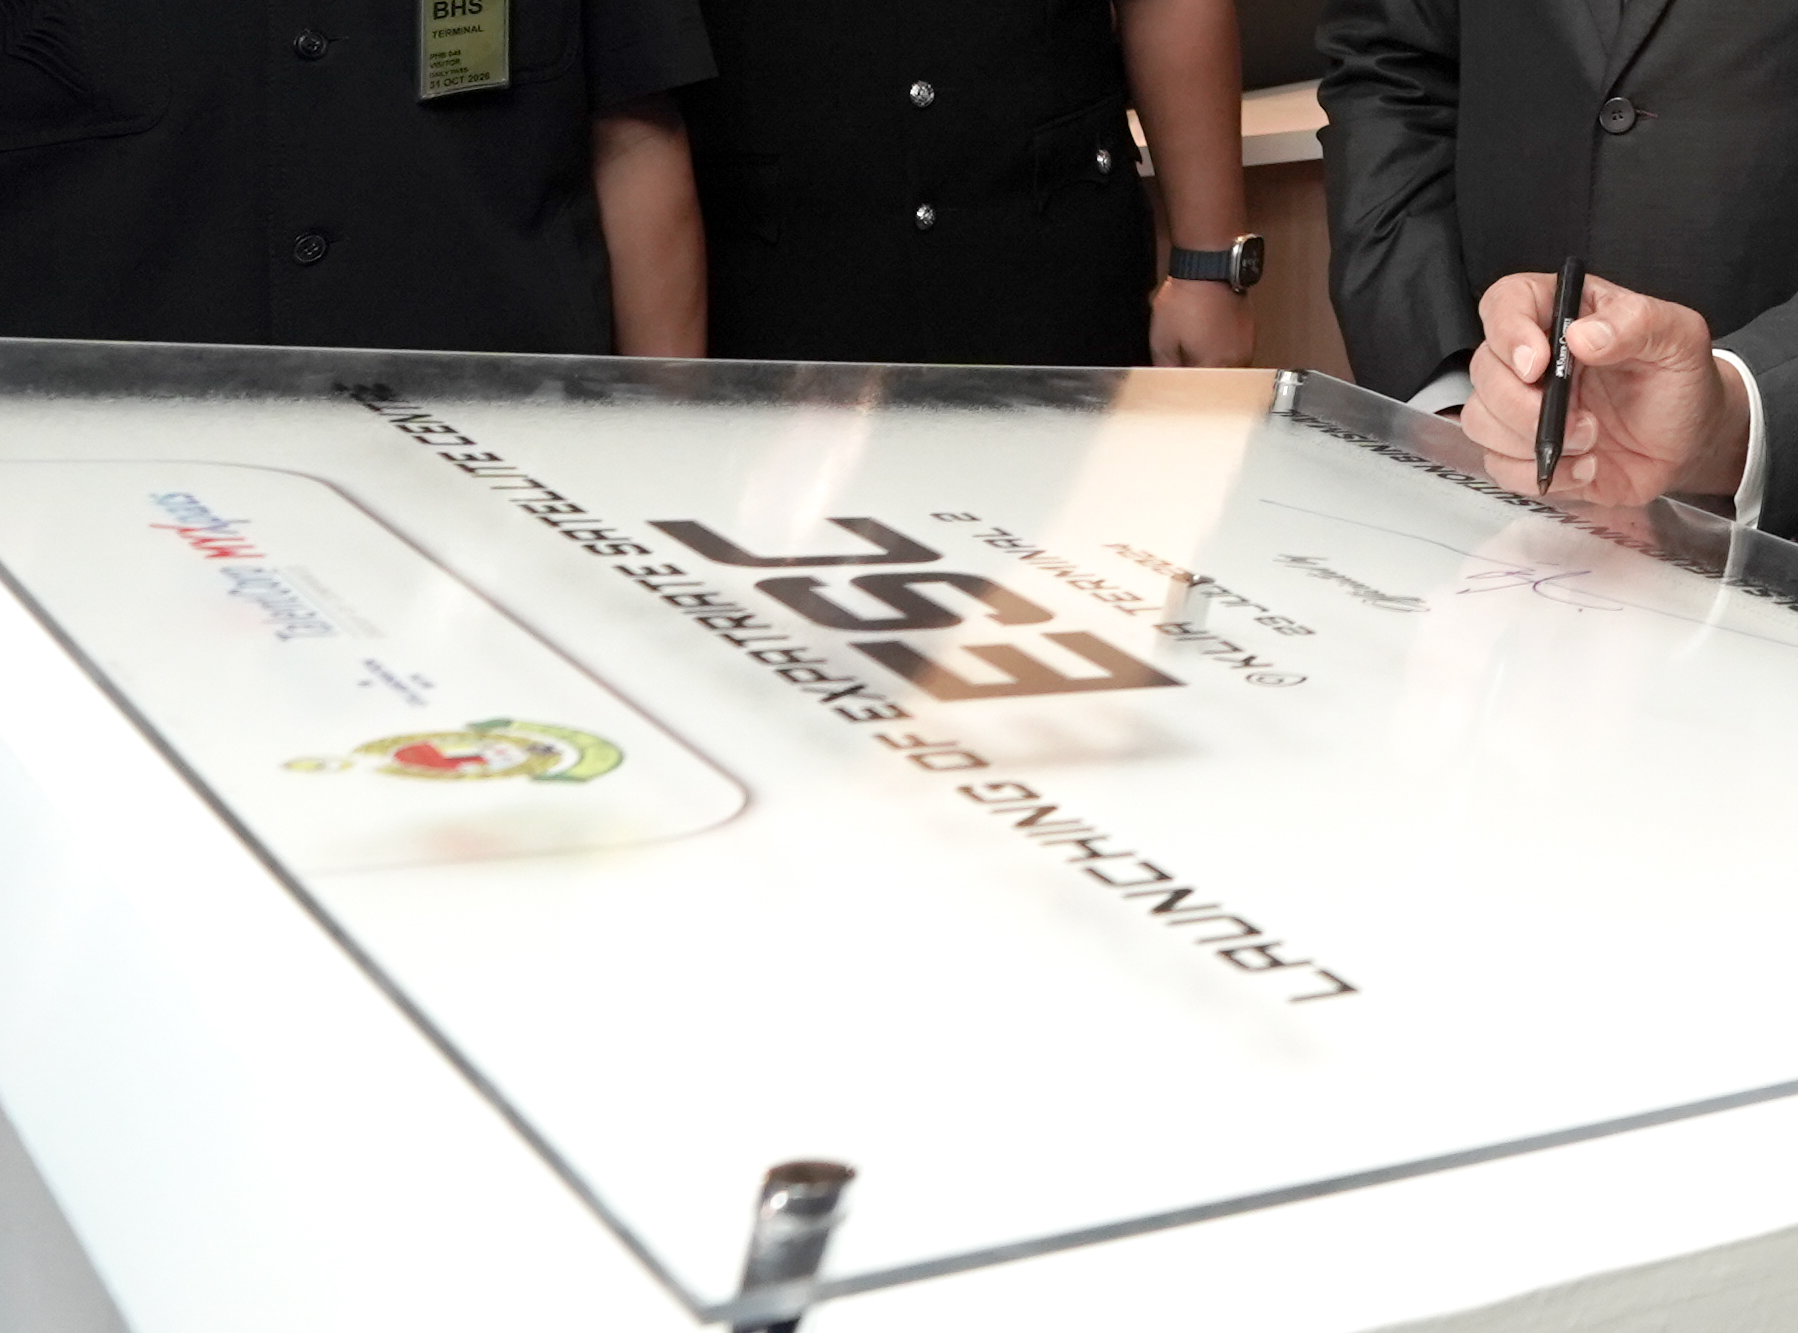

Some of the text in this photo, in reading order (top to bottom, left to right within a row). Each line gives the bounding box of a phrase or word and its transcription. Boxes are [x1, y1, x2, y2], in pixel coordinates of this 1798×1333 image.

[432, 25, 485, 39] TERMINAL
[443, 75, 465, 88] OCT
[436, 449, 654, 558] SATELLITE
[612, 562, 914, 723] EXPATRIATE
[645, 514, 1189, 704] ESC
[929, 510, 1275, 670] KLIA TERMINAL 2
[872, 732, 990, 773] OF
[957, 780, 1361, 1005] LAUNCHING
